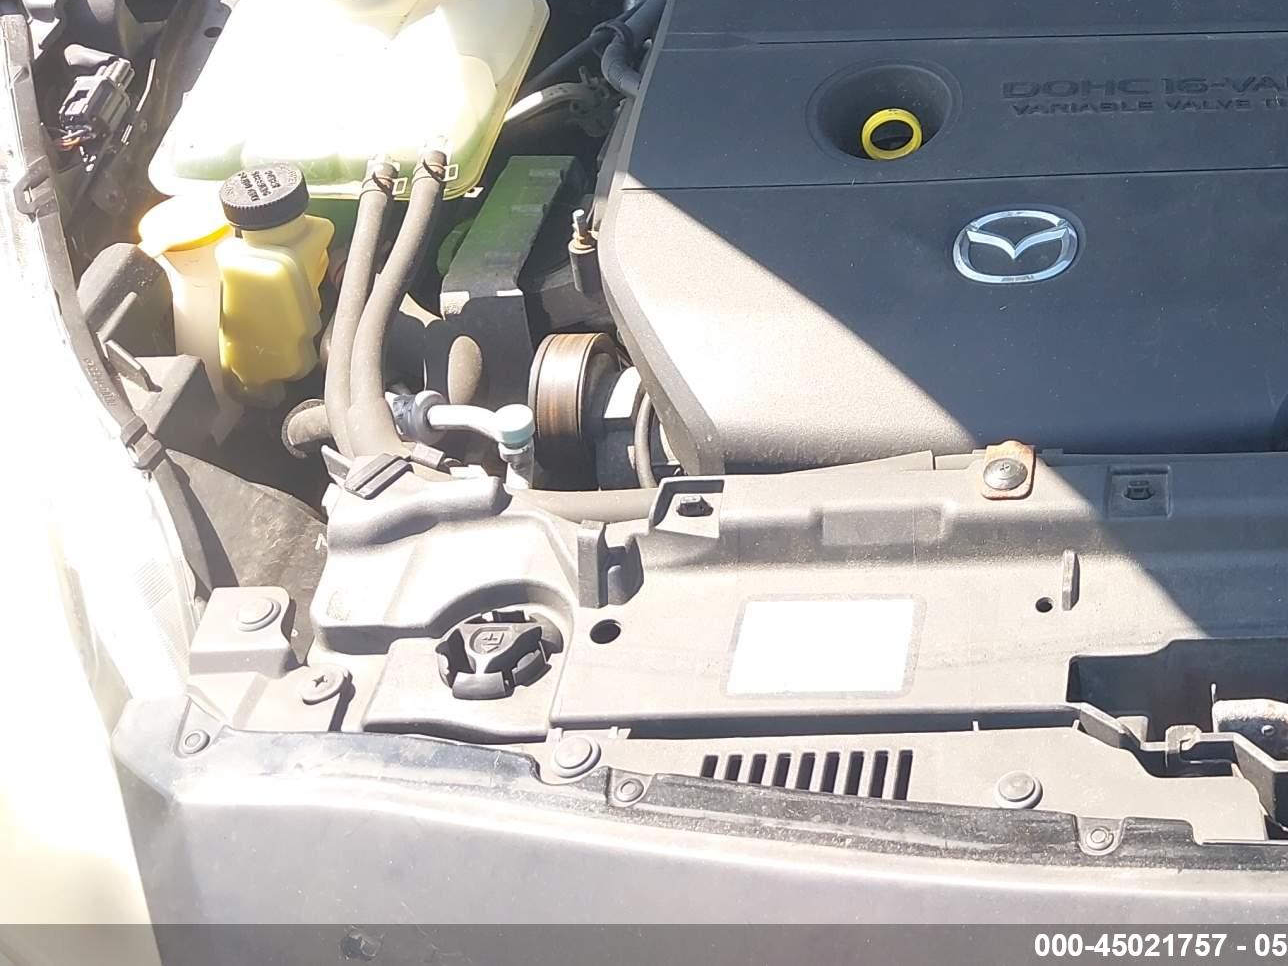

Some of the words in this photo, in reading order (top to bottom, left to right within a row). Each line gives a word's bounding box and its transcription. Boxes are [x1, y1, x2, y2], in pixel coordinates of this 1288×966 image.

[1002, 77, 1151, 99] DOHC
[1012, 100, 1154, 117] VARIABLE
[1165, 98, 1251, 114] VALVE
